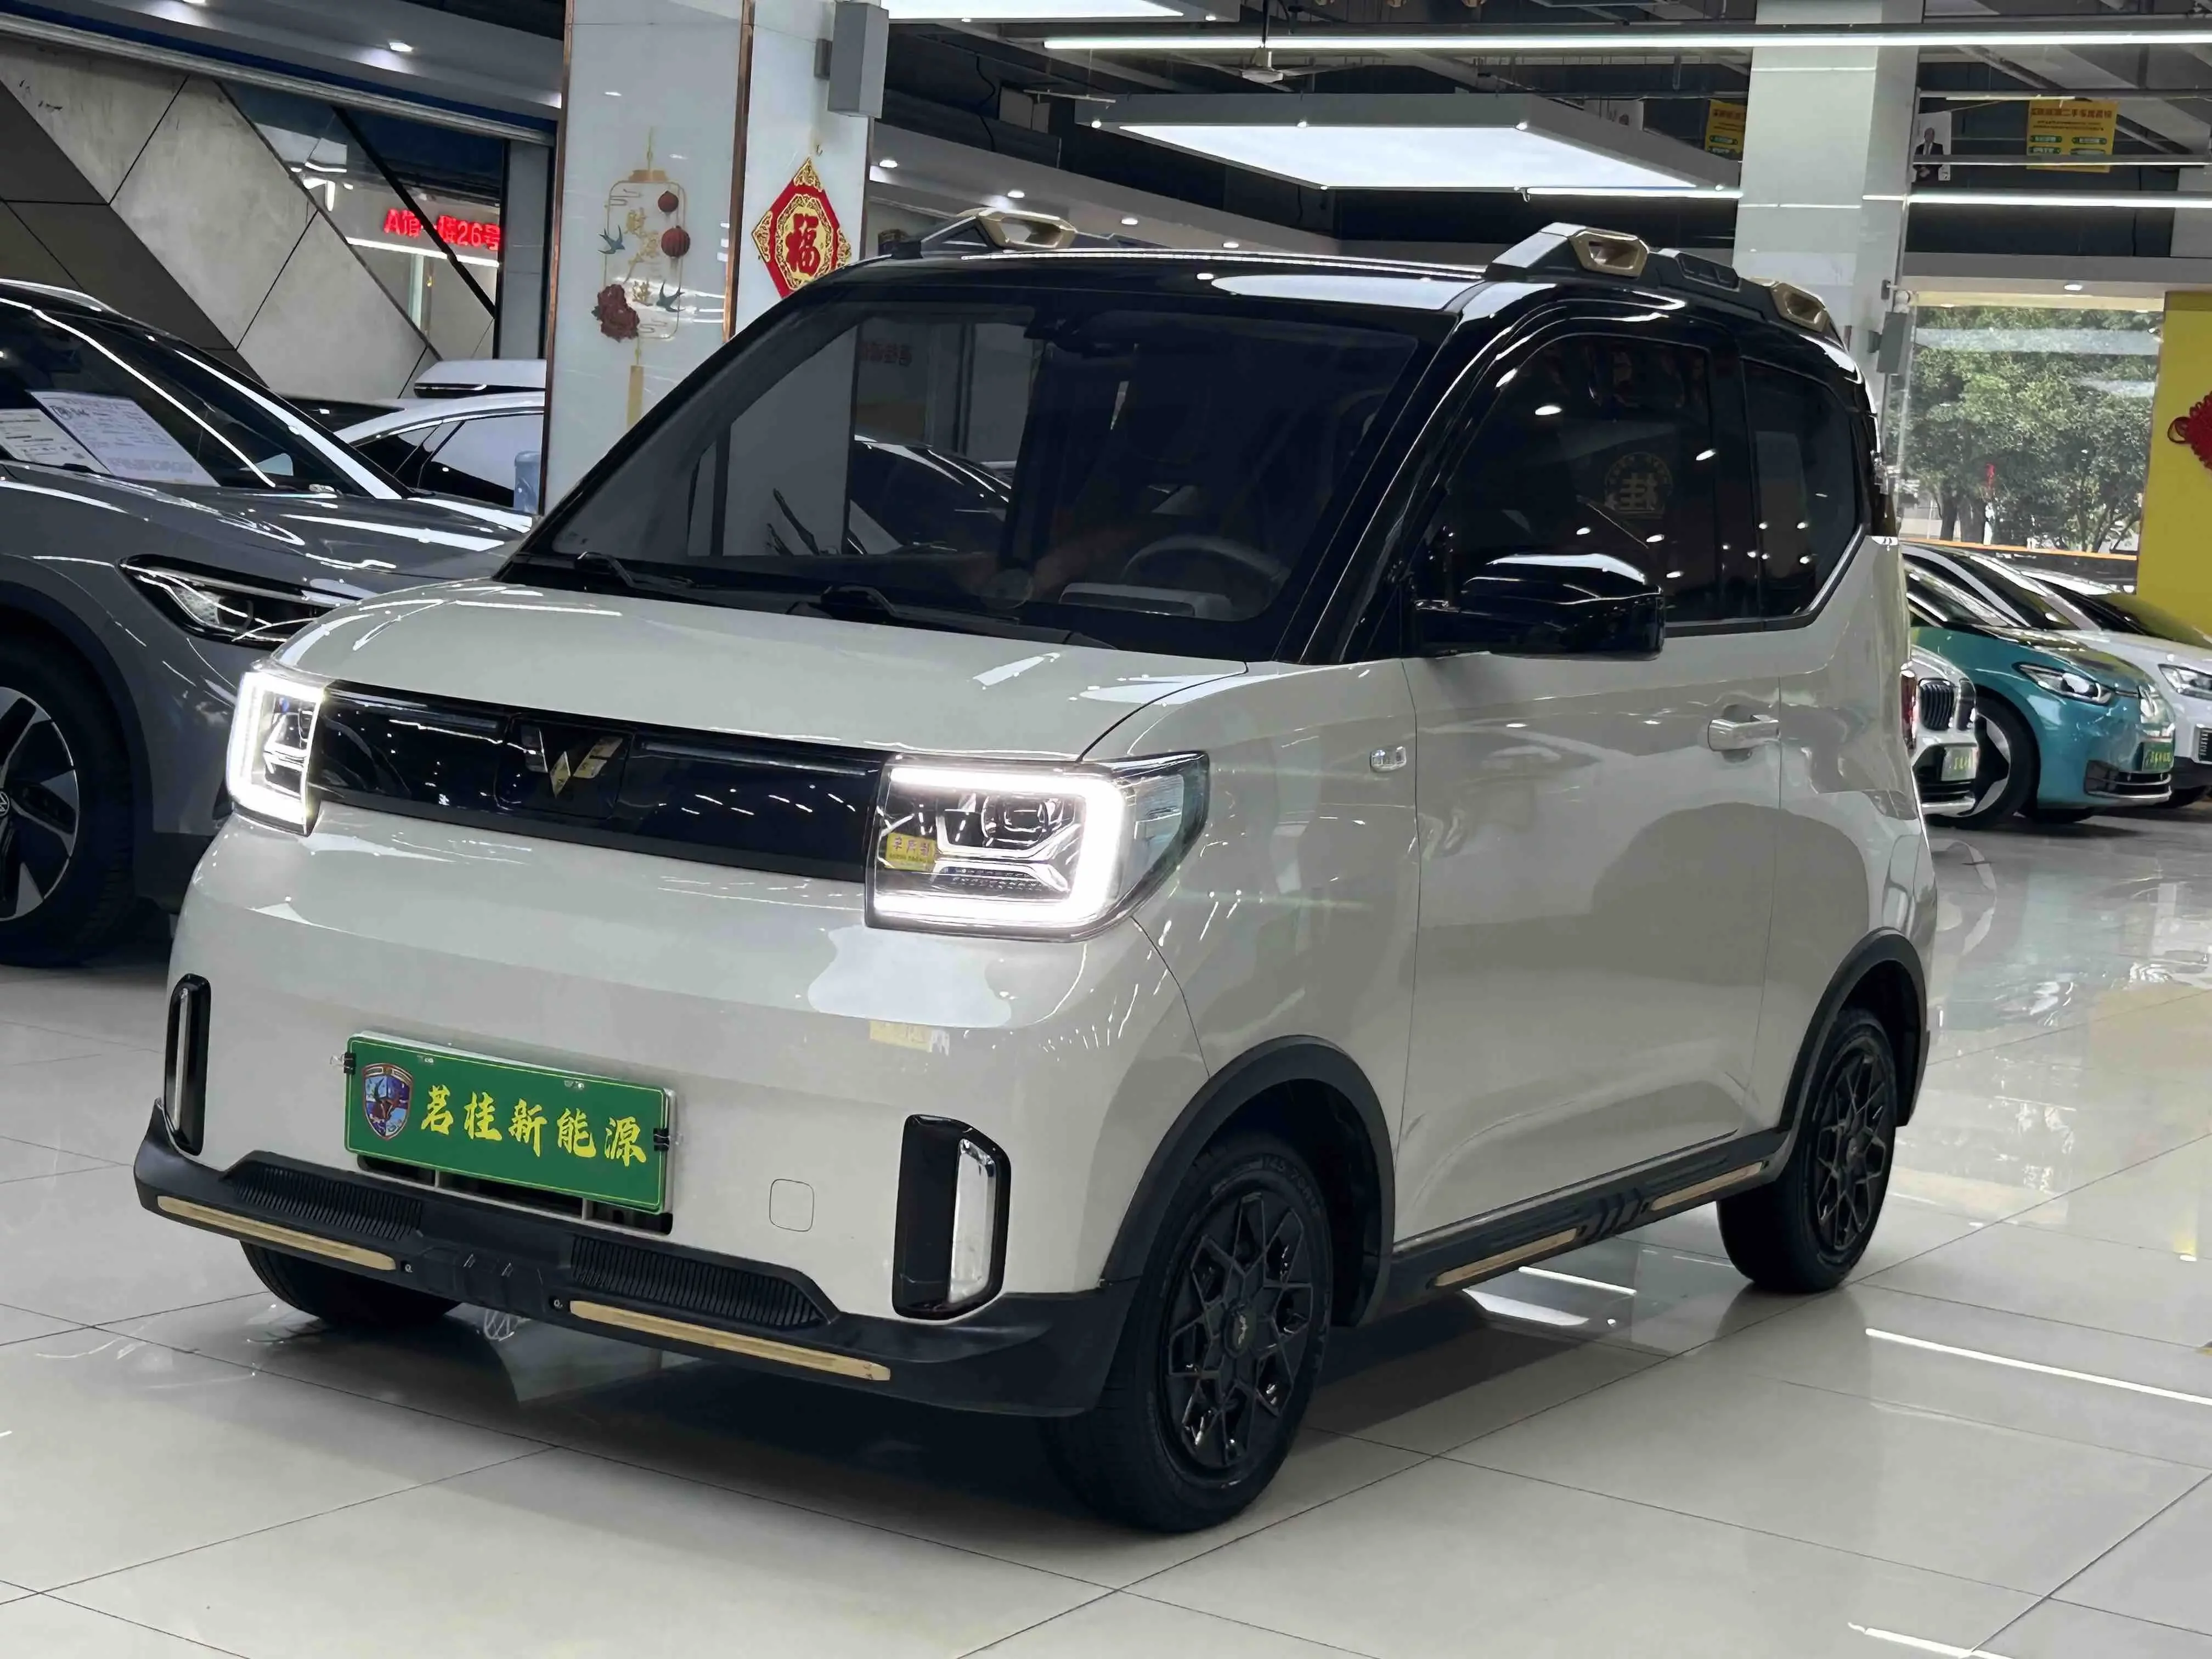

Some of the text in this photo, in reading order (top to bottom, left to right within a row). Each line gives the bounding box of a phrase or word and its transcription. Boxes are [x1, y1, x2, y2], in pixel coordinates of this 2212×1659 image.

[786, 213, 820, 276] 福
[421, 1084, 647, 1167] 茗桂新能源
